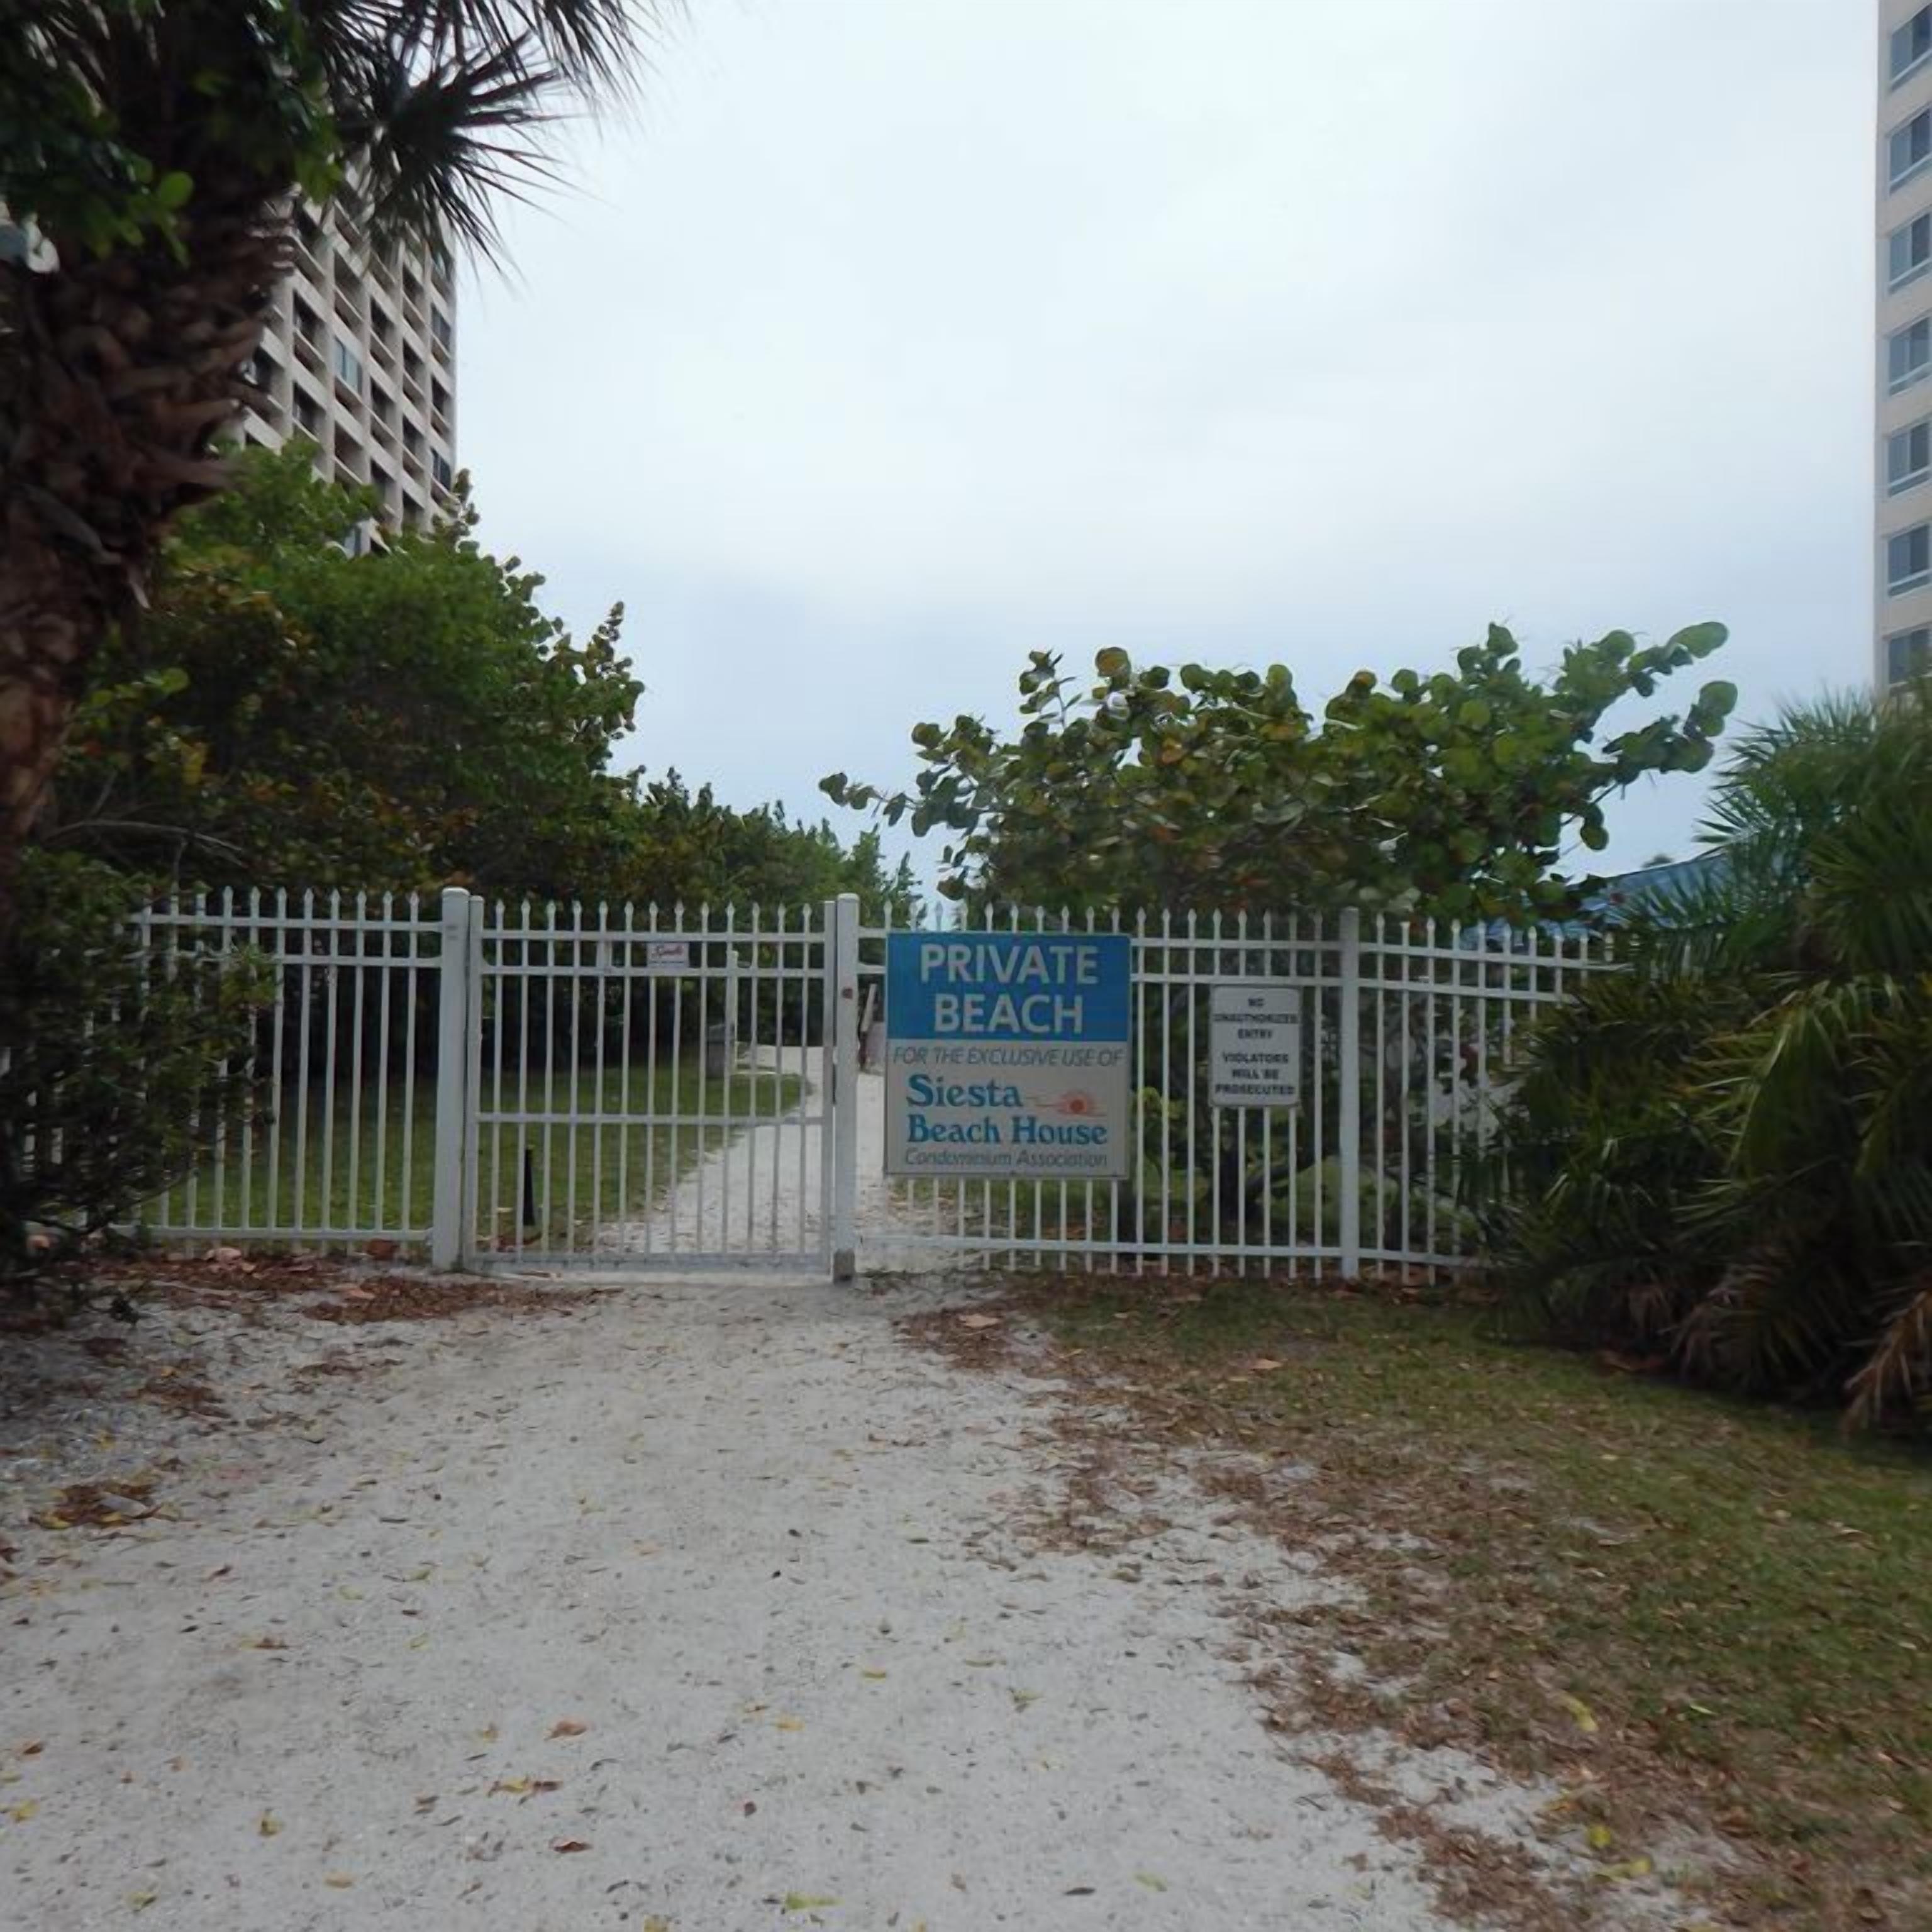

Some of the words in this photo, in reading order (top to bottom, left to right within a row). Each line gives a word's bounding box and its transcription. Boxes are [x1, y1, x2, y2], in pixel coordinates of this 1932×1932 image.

[920, 943, 1099, 985] PRIVATE
[935, 993, 1084, 1033] BEACH
[893, 1046, 928, 1065] FOR
[934, 1048, 964, 1065] THE
[967, 1048, 1063, 1066] EXCLUSIVE
[1062, 1049, 1096, 1066] USE
[1097, 1049, 1124, 1067] OF
[906, 1074, 1024, 1108] Siesta
[908, 1114, 1001, 1143] Beach
[1011, 1116, 1108, 1145] House
[905, 1148, 1011, 1166] Condominium
[1017, 1150, 1107, 1167] Association
